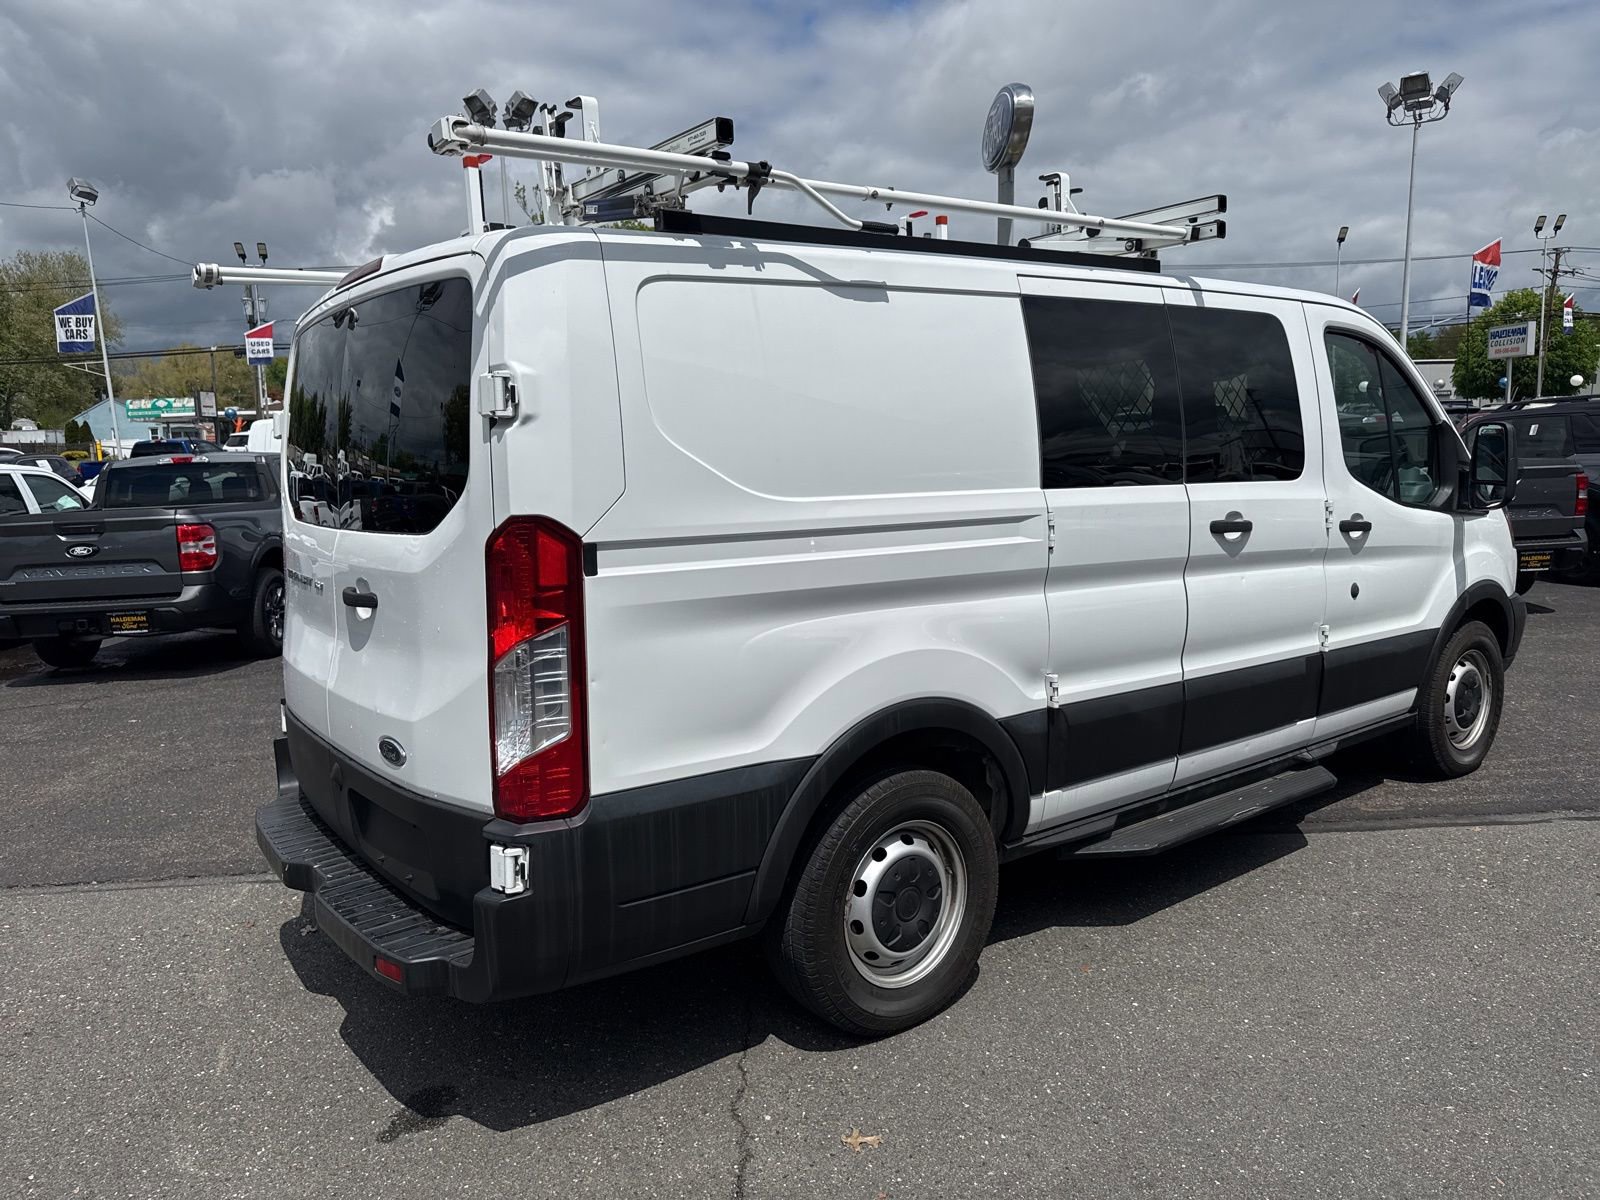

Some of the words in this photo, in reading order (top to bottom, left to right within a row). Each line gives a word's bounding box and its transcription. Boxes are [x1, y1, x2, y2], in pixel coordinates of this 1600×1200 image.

[58, 317, 72, 328] WE
[75, 317, 93, 328] BUY
[65, 328, 88, 340] CARS
[1490, 337, 1526, 347] COLLISION
[22, 565, 153, 579] MAVERICK
